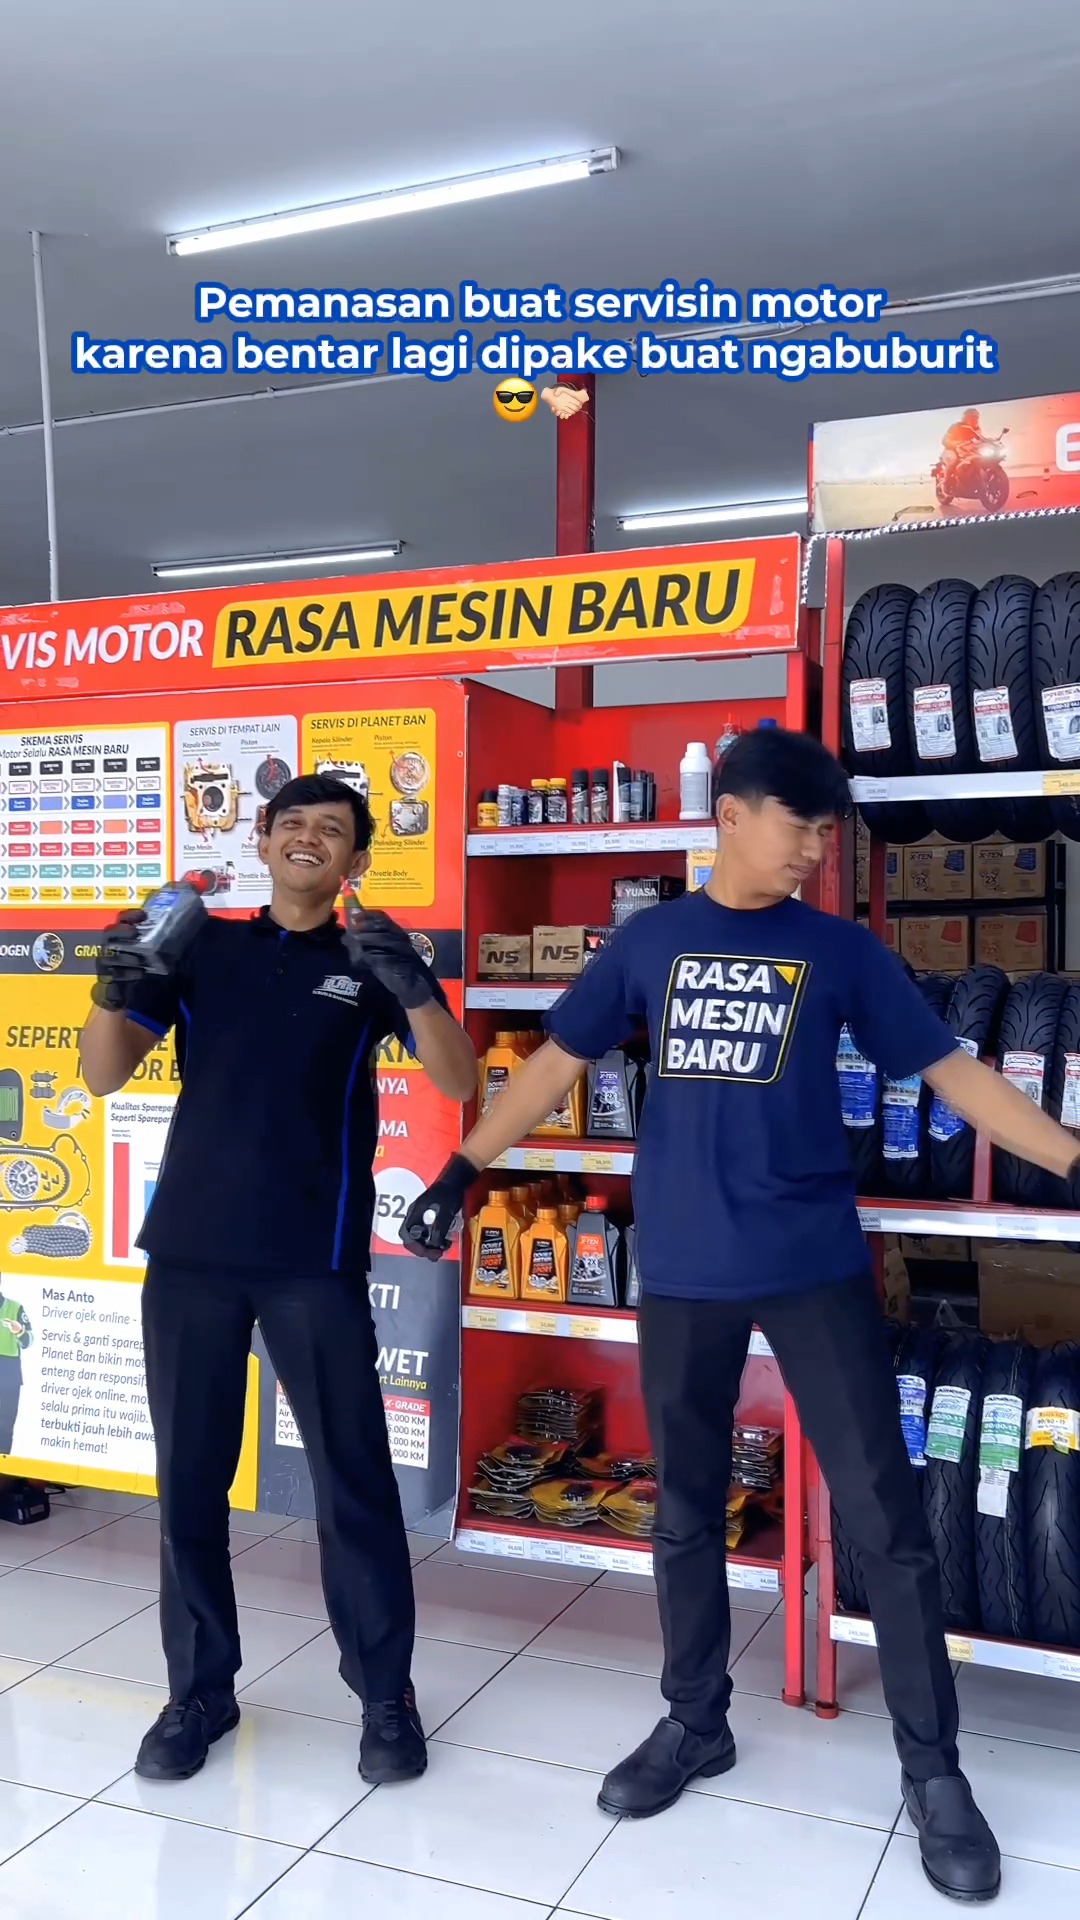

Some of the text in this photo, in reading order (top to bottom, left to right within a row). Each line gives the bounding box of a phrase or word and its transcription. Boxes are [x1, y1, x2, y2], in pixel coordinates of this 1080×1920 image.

[63, 619, 204, 666] MOTOR
[225, 601, 361, 659] RASA
[373, 585, 553, 648] MESIN
[567, 569, 741, 635] BARU
[189, 723, 281, 736] SERVIS DI TEMPAT LAIN
[310, 714, 427, 730] SERVIS DI PLANET BAN
[20, 734, 83, 747] SKEMA SERVIS
[23, 747, 47, 758] Selalu
[49, 747, 72, 757] RASA
[73, 745, 102, 756] MESIN
[104, 744, 130, 754] BARU
[625, 887, 657, 897] YUASA
[486, 950, 521, 964] NS
[541, 945, 580, 961] NS
[675, 960, 772, 994] RASA
[670, 998, 787, 1036] MESIN
[666, 1038, 762, 1074] BARU
[111, 1102, 140, 1111] Kualitas
[110, 1113, 136, 1124] Seperti
[42, 1288, 95, 1304] Mas Anto
[42, 1305, 73, 1319] Driver
[75, 1309, 97, 1323] ojek
[99, 1312, 130, 1325] online
[42, 1329, 71, 1343] Servis
[73, 1331, 82, 1344] &
[83, 1335, 110, 1347] ganti
[41, 1347, 74, 1361] Planet
[76, 1349, 96, 1363] Ban
[98, 1352, 123, 1366] bikin
[41, 1366, 76, 1381] enteng
[78, 1368, 97, 1381] dan
[41, 1382, 70, 1396] driver
[72, 1386, 93, 1399] ojek
[390, 1374, 427, 1391] Lainnya
[41, 1400, 149, 1424] selalu prima itu wajib.
[41, 1417, 81, 1433] terbukti
[82, 1422, 105, 1436] jauh
[107, 1424, 132, 1439] lebih
[278, 1419, 295, 1429] CVT
[411, 1416, 426, 1426] KM
[278, 1431, 294, 1440] CVT
[411, 1428, 425, 1438] KM
[40, 1436, 108, 1454] makin hemat!
[410, 1439, 425, 1450] KM
[410, 1451, 424, 1461] KM
